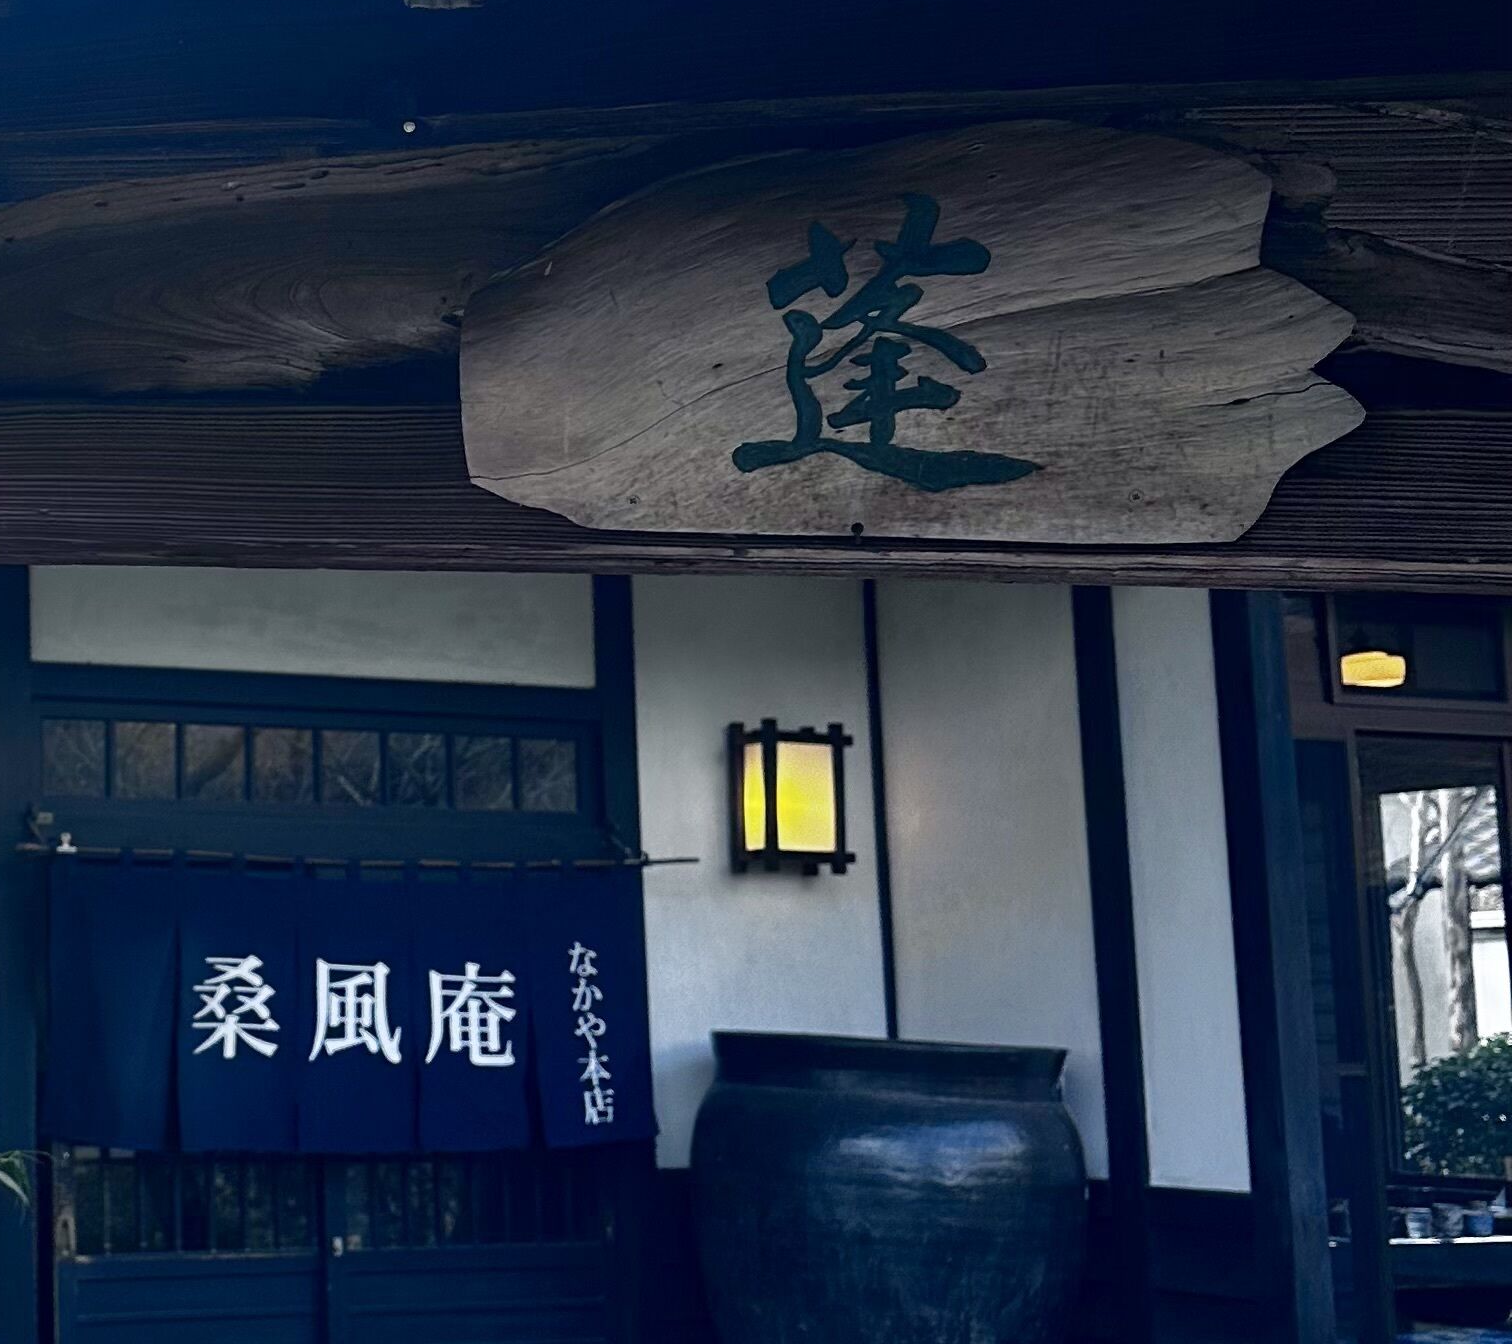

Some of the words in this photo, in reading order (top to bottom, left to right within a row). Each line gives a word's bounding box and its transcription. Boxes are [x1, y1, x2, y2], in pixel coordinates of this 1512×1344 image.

[732, 191, 1045, 492] 蓬
[191, 954, 518, 1068] 桑風庵
[567, 941, 616, 1126] なかや本店
